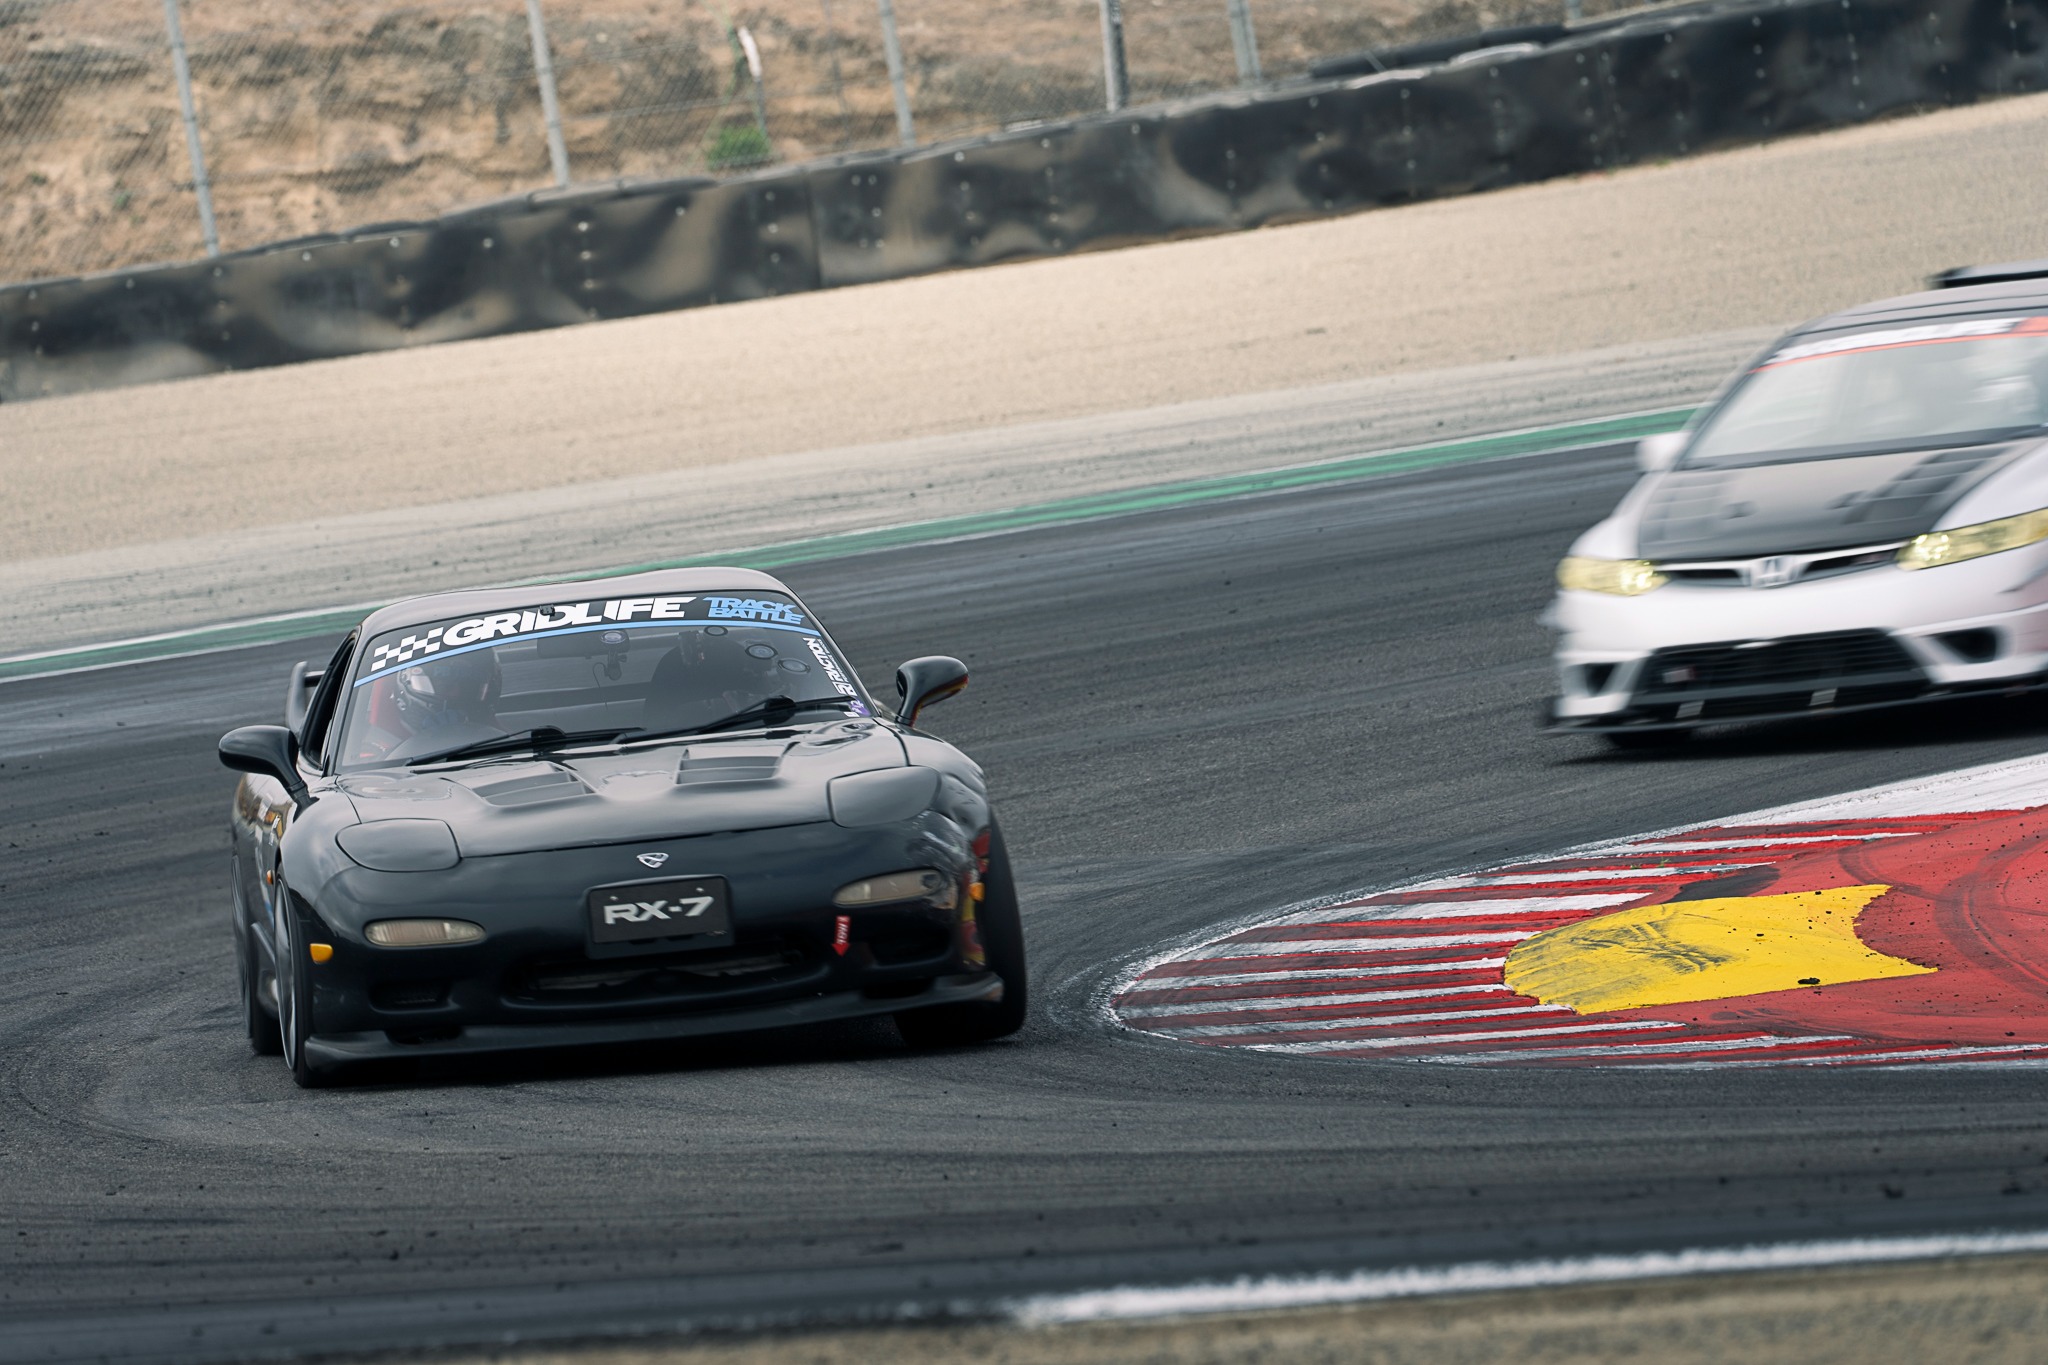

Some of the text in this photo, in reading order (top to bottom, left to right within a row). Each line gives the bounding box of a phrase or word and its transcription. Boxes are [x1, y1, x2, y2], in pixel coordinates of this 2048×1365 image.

[703, 597, 796, 614] TRACK
[708, 607, 805, 625] BATTLE
[443, 597, 697, 645] GRIDLIFE
[603, 896, 714, 925] RX-7
